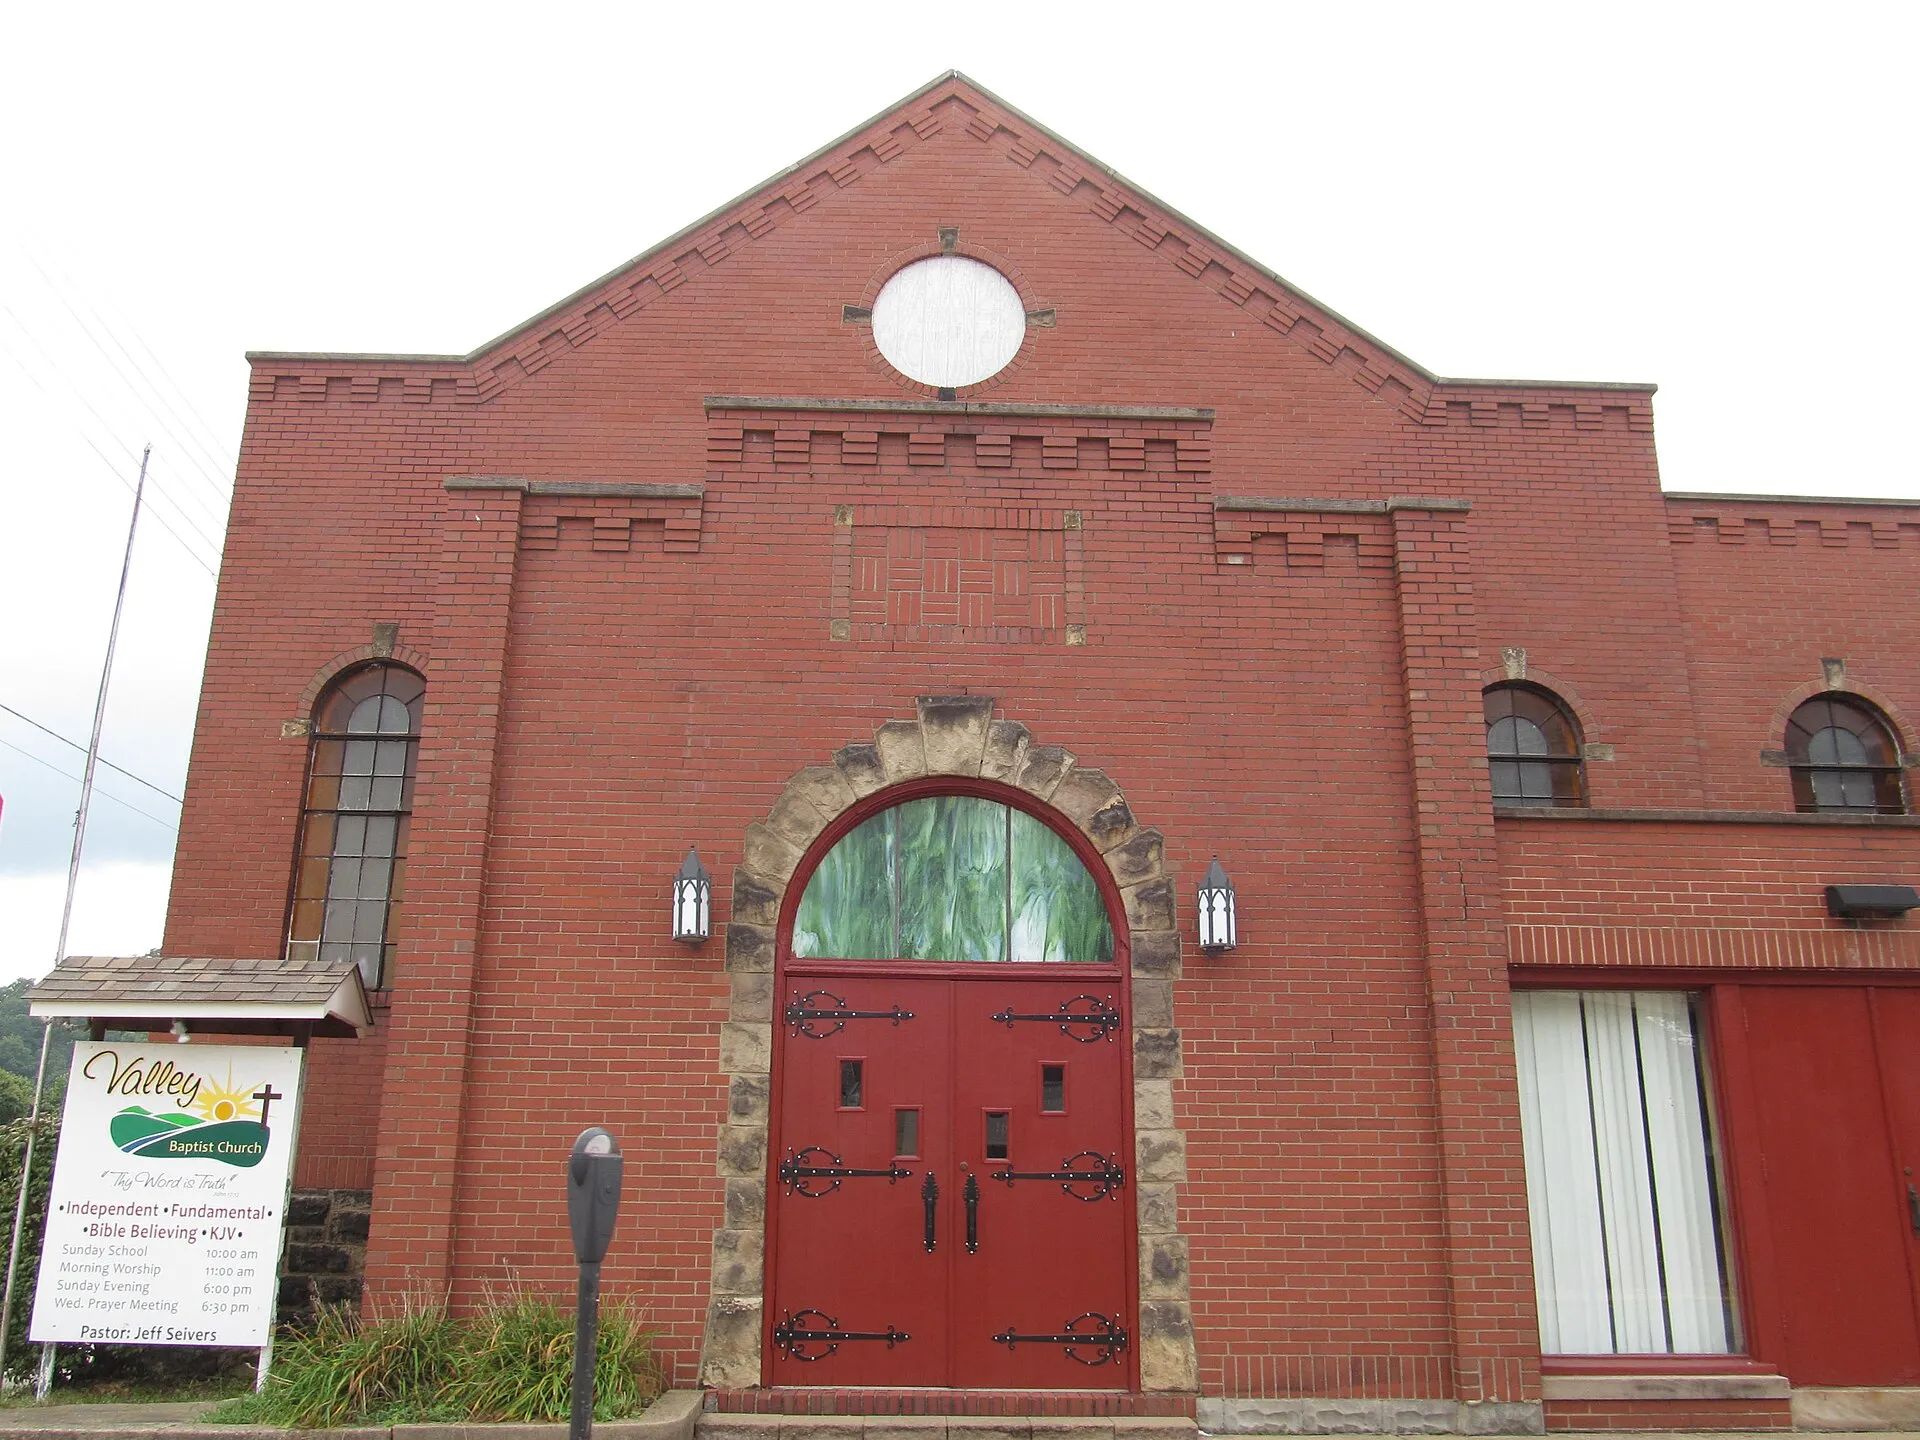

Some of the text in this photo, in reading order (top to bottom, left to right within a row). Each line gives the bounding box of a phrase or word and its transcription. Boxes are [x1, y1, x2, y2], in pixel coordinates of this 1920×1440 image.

[83, 1050, 202, 1108] Valley
[169, 1140, 262, 1155] Baptist Church
[134, 1171, 182, 1188] Word
[183, 1177, 195, 1189] is
[66, 1200, 265, 1220] Independent Fundamental
[89, 1222, 237, 1244] Bible Believing KJV
[61, 1243, 258, 1259] Sunday School 10:00 am
[59, 1262, 255, 1277] Morning Worship 11:00 am
[56, 1279, 252, 1297] Sunday Evening 6:00 pm
[54, 1298, 250, 1315] Wed. Prayer Meeting 6:30 pm
[80, 1325, 217, 1341] Pastor: Jeff Seivers
